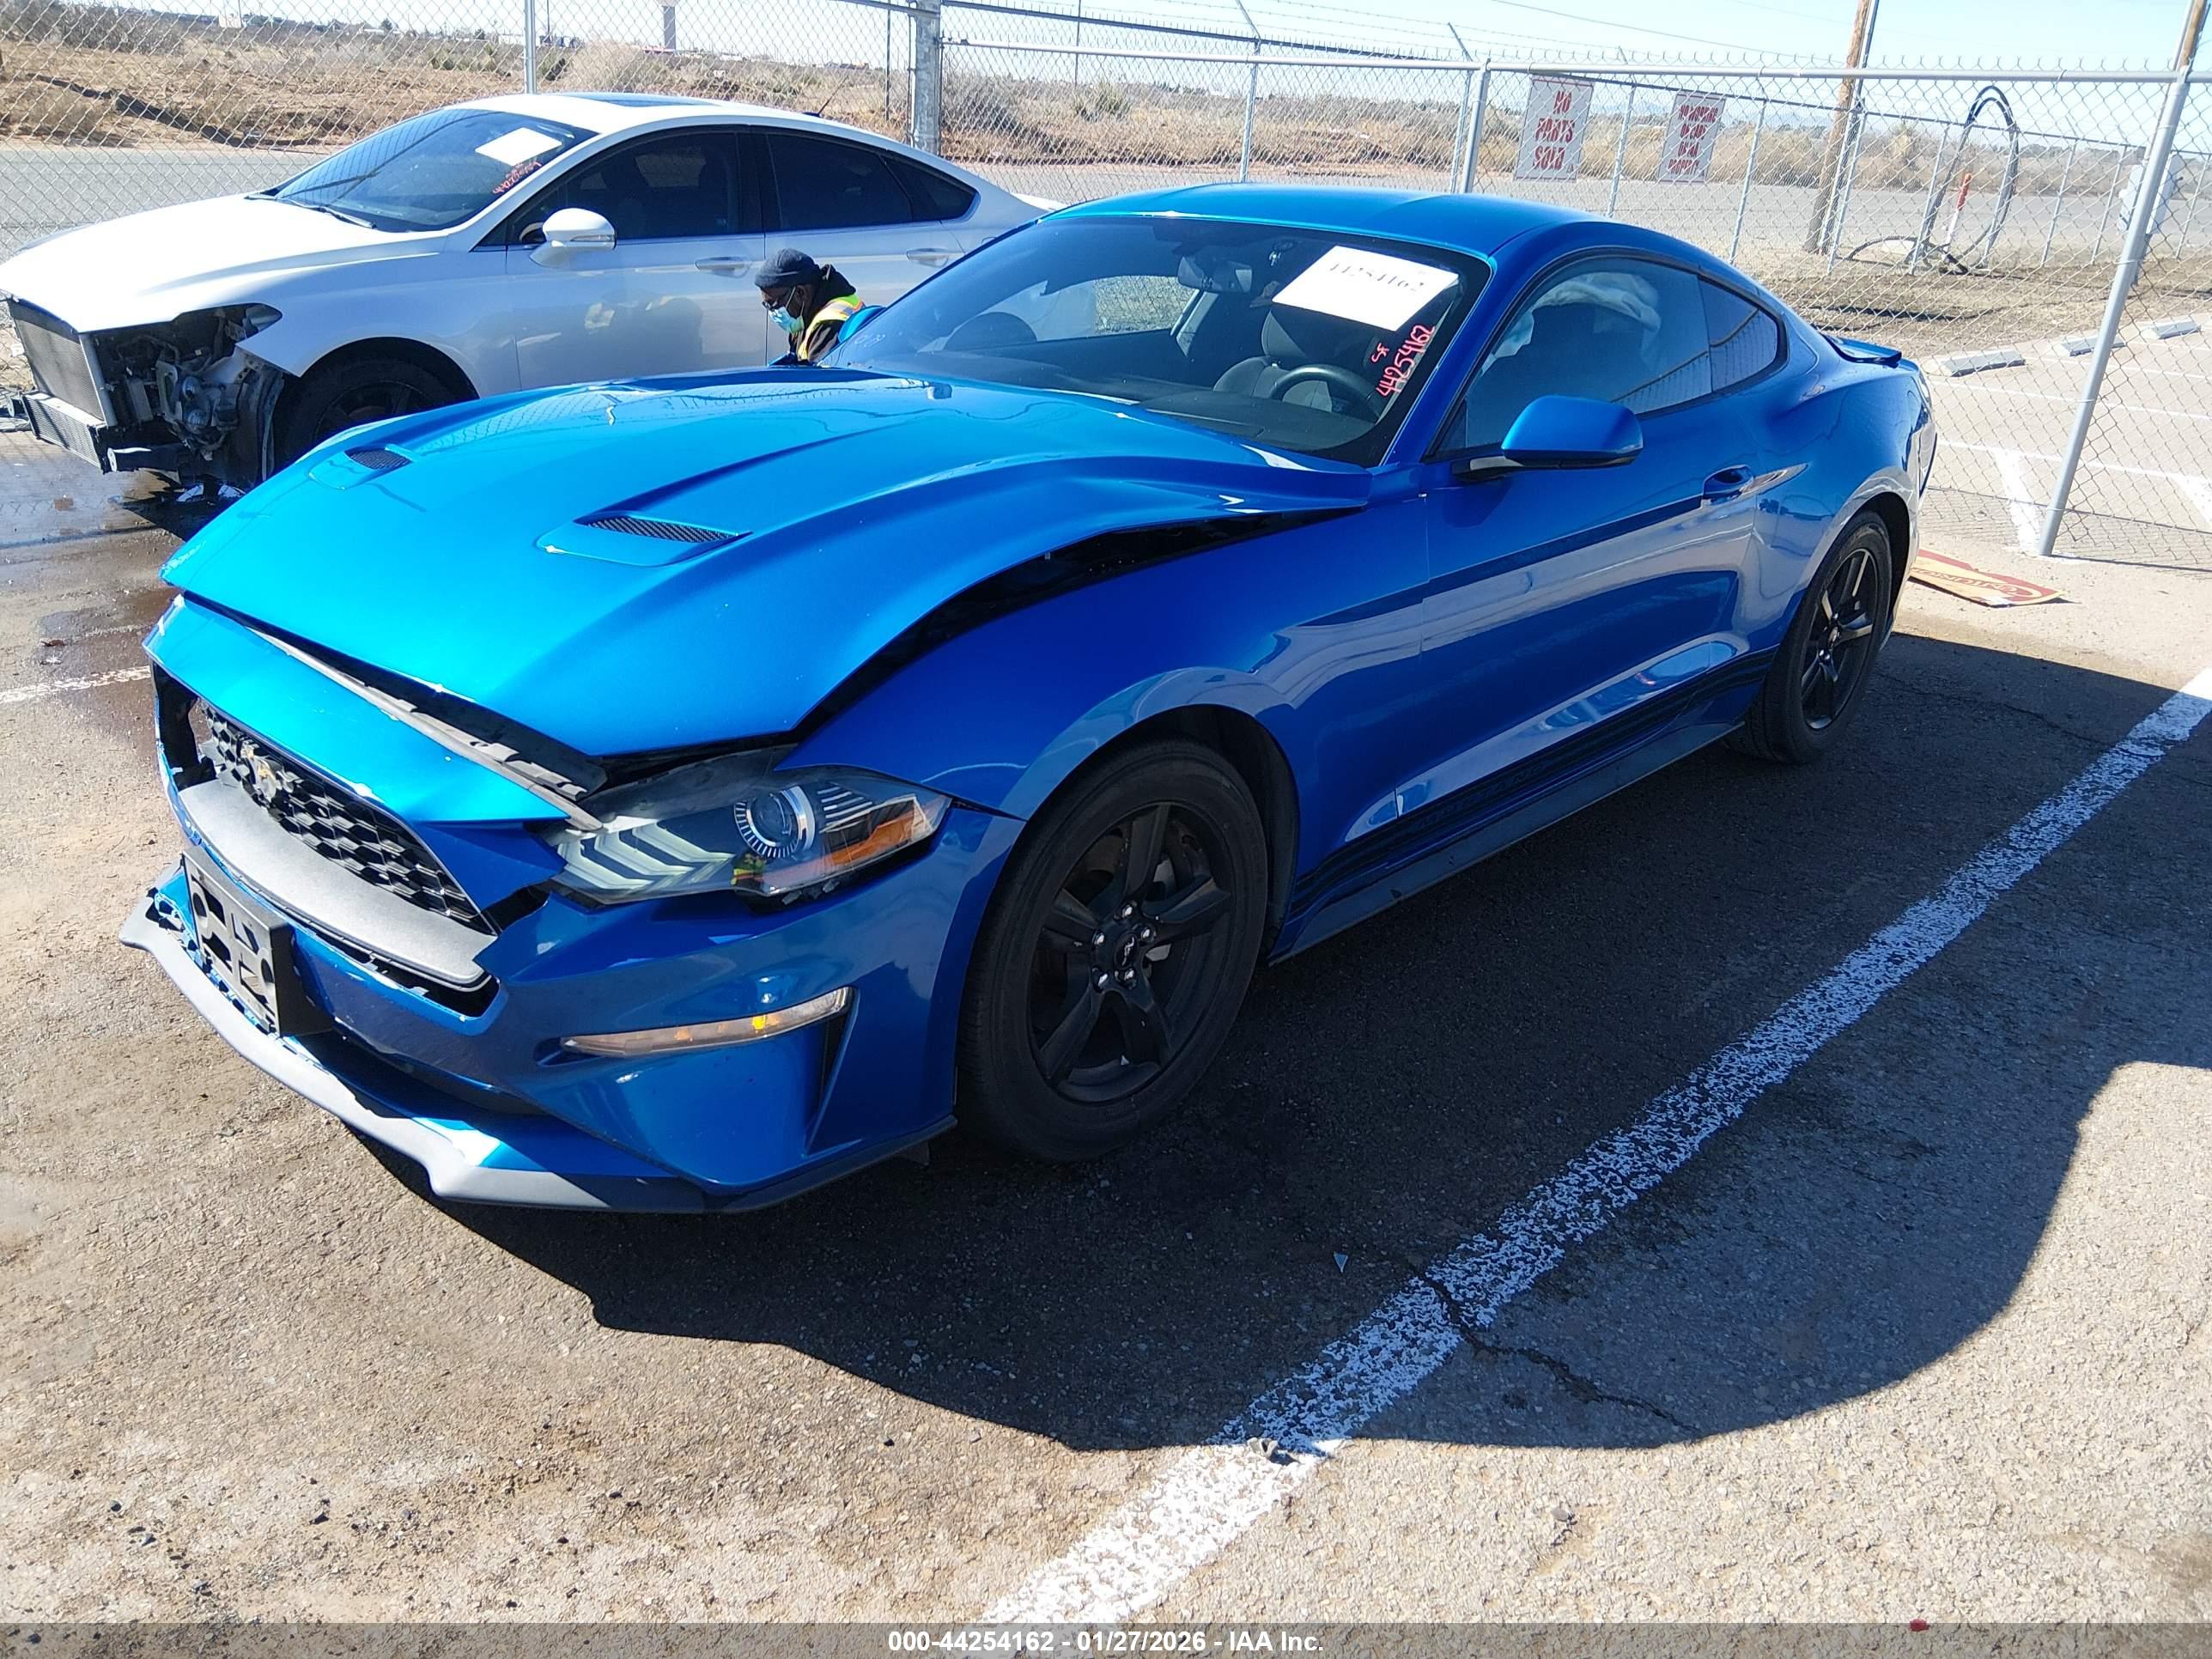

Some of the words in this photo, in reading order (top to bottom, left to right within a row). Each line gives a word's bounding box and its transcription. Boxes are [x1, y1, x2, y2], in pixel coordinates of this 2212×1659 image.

[1553, 91, 1572, 115] NO
[1679, 105, 1689, 120] NO
[1534, 117, 1575, 143] PARTS
[1533, 145, 1565, 171] SOLD
[1668, 159, 1700, 175] PROPERTY
[1376, 324, 1436, 397] 44254162
